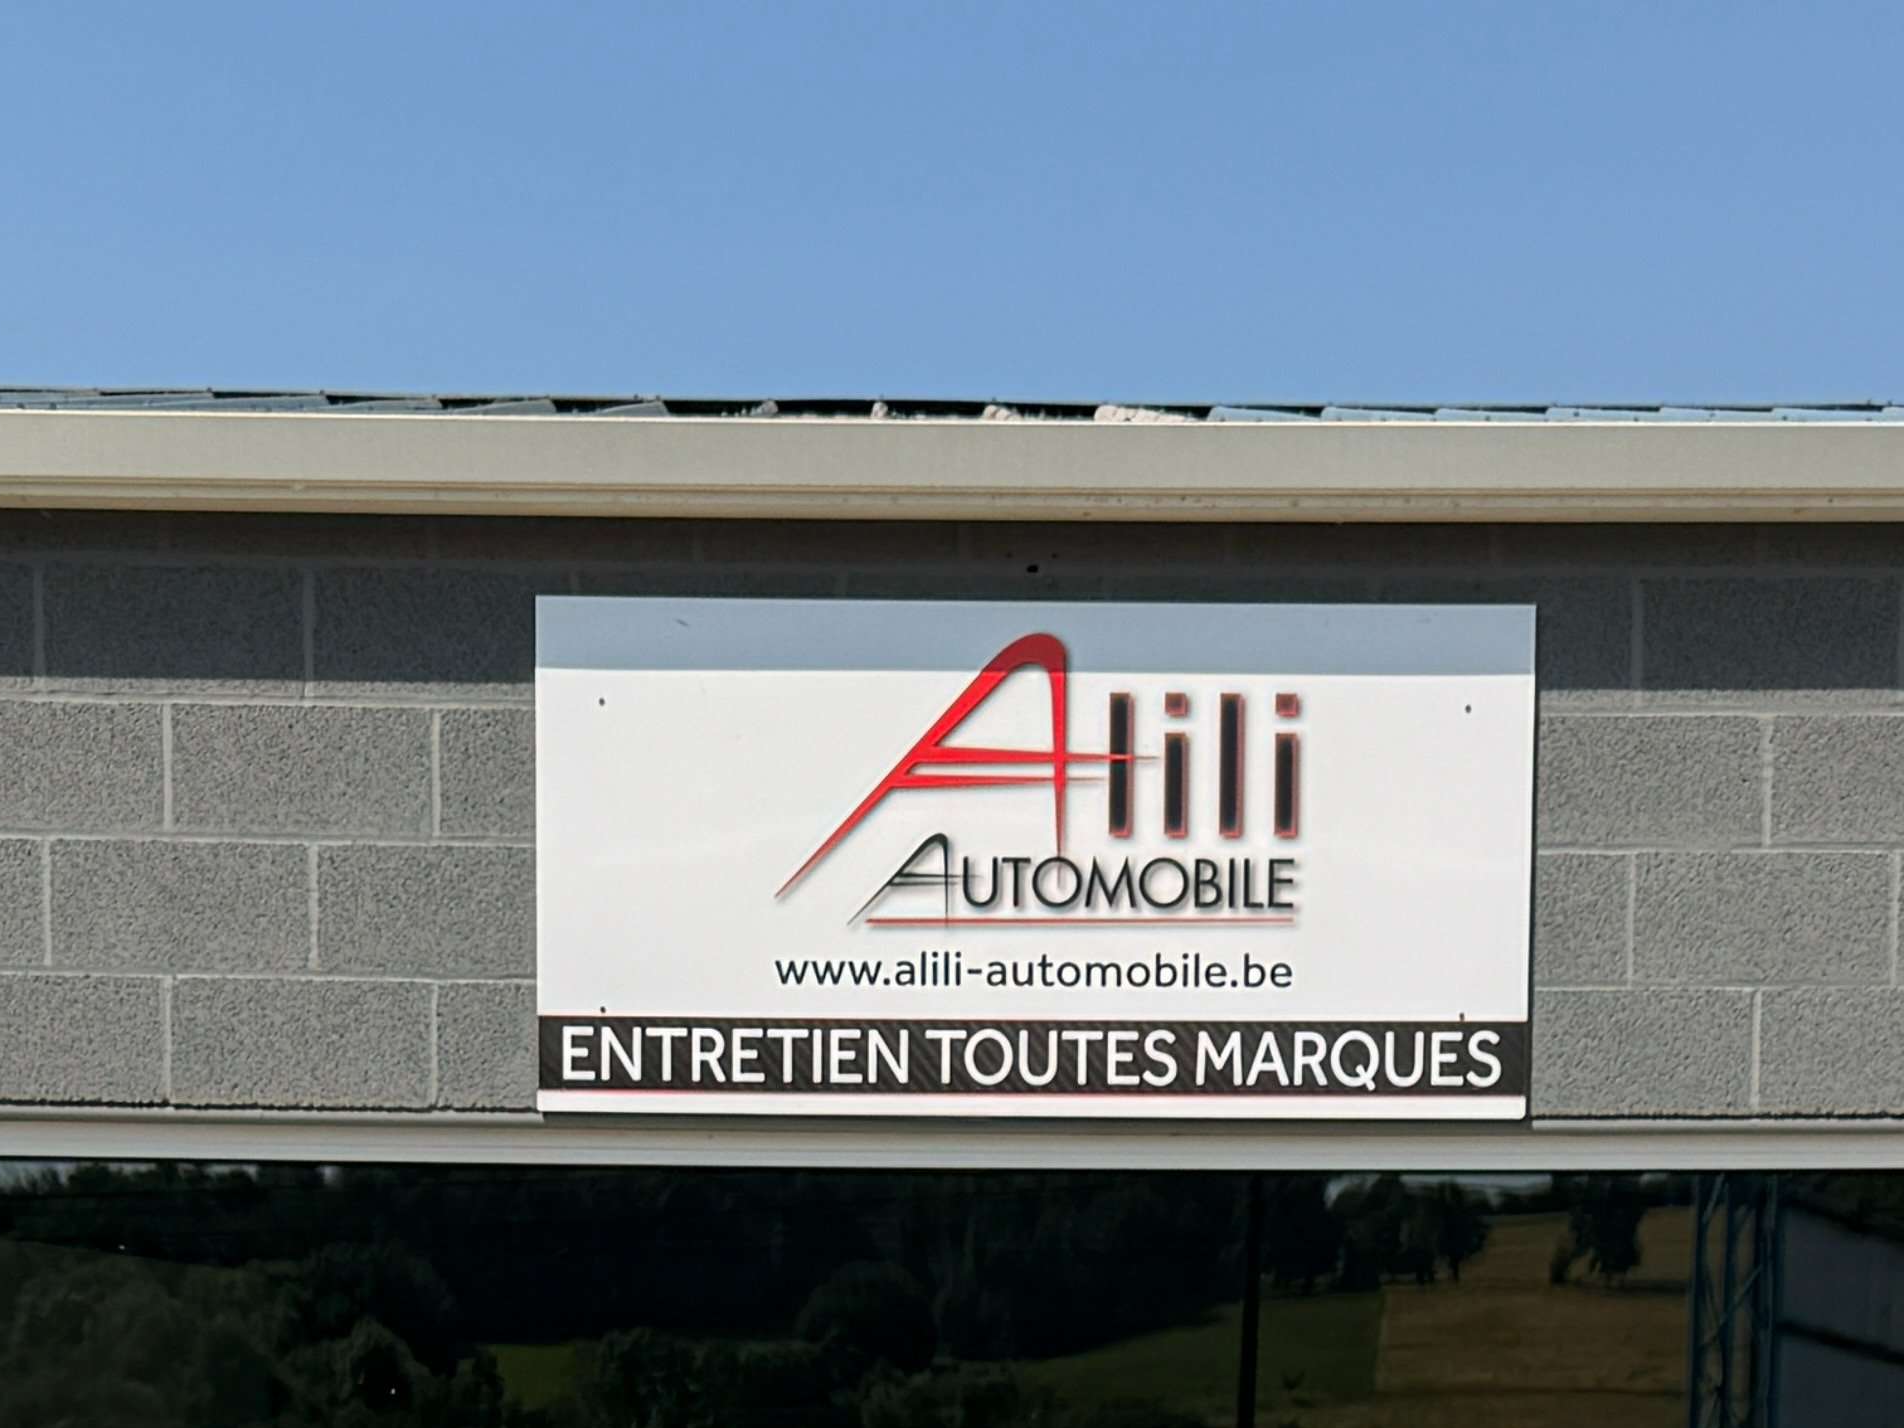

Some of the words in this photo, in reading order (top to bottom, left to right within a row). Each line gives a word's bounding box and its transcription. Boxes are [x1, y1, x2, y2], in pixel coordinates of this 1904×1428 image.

[775, 632, 1302, 898] Alili
[847, 832, 1296, 926] AUTOMOBILE
[774, 950, 1294, 988] www.alili-automobile.be
[561, 1024, 909, 1085] ENTRETIEN
[924, 1028, 1178, 1087] TOUTES
[1195, 1029, 1503, 1091] MARQUES
